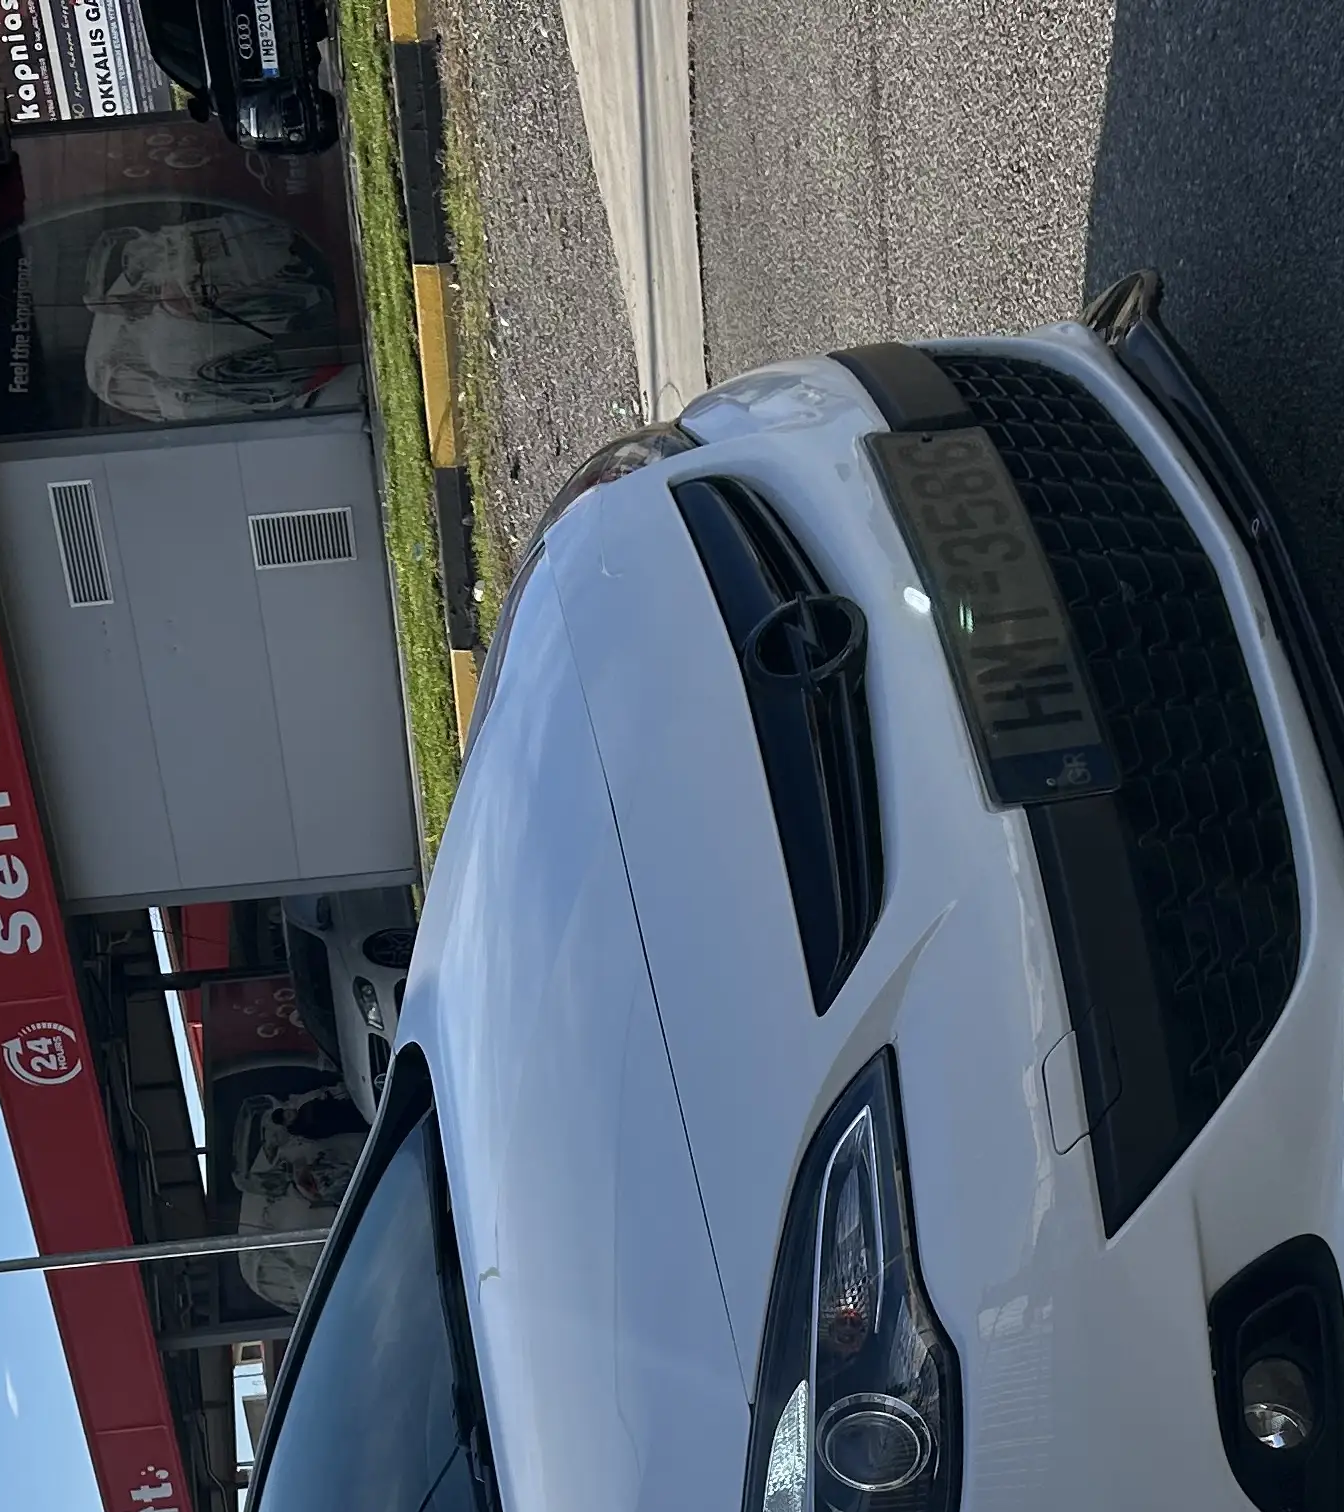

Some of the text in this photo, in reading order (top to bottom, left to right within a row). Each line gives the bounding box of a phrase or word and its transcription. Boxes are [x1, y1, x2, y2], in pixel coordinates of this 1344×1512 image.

[1, 0, 40, 120] kapnias
[88, 28, 118, 117] OKKALIS
[9, 333, 32, 360] the
[7, 362, 30, 393] Feel
[1061, 751, 1093, 785] GR
[26, 1037, 58, 1072] 24
[51, 1035, 69, 1071] HOURS
